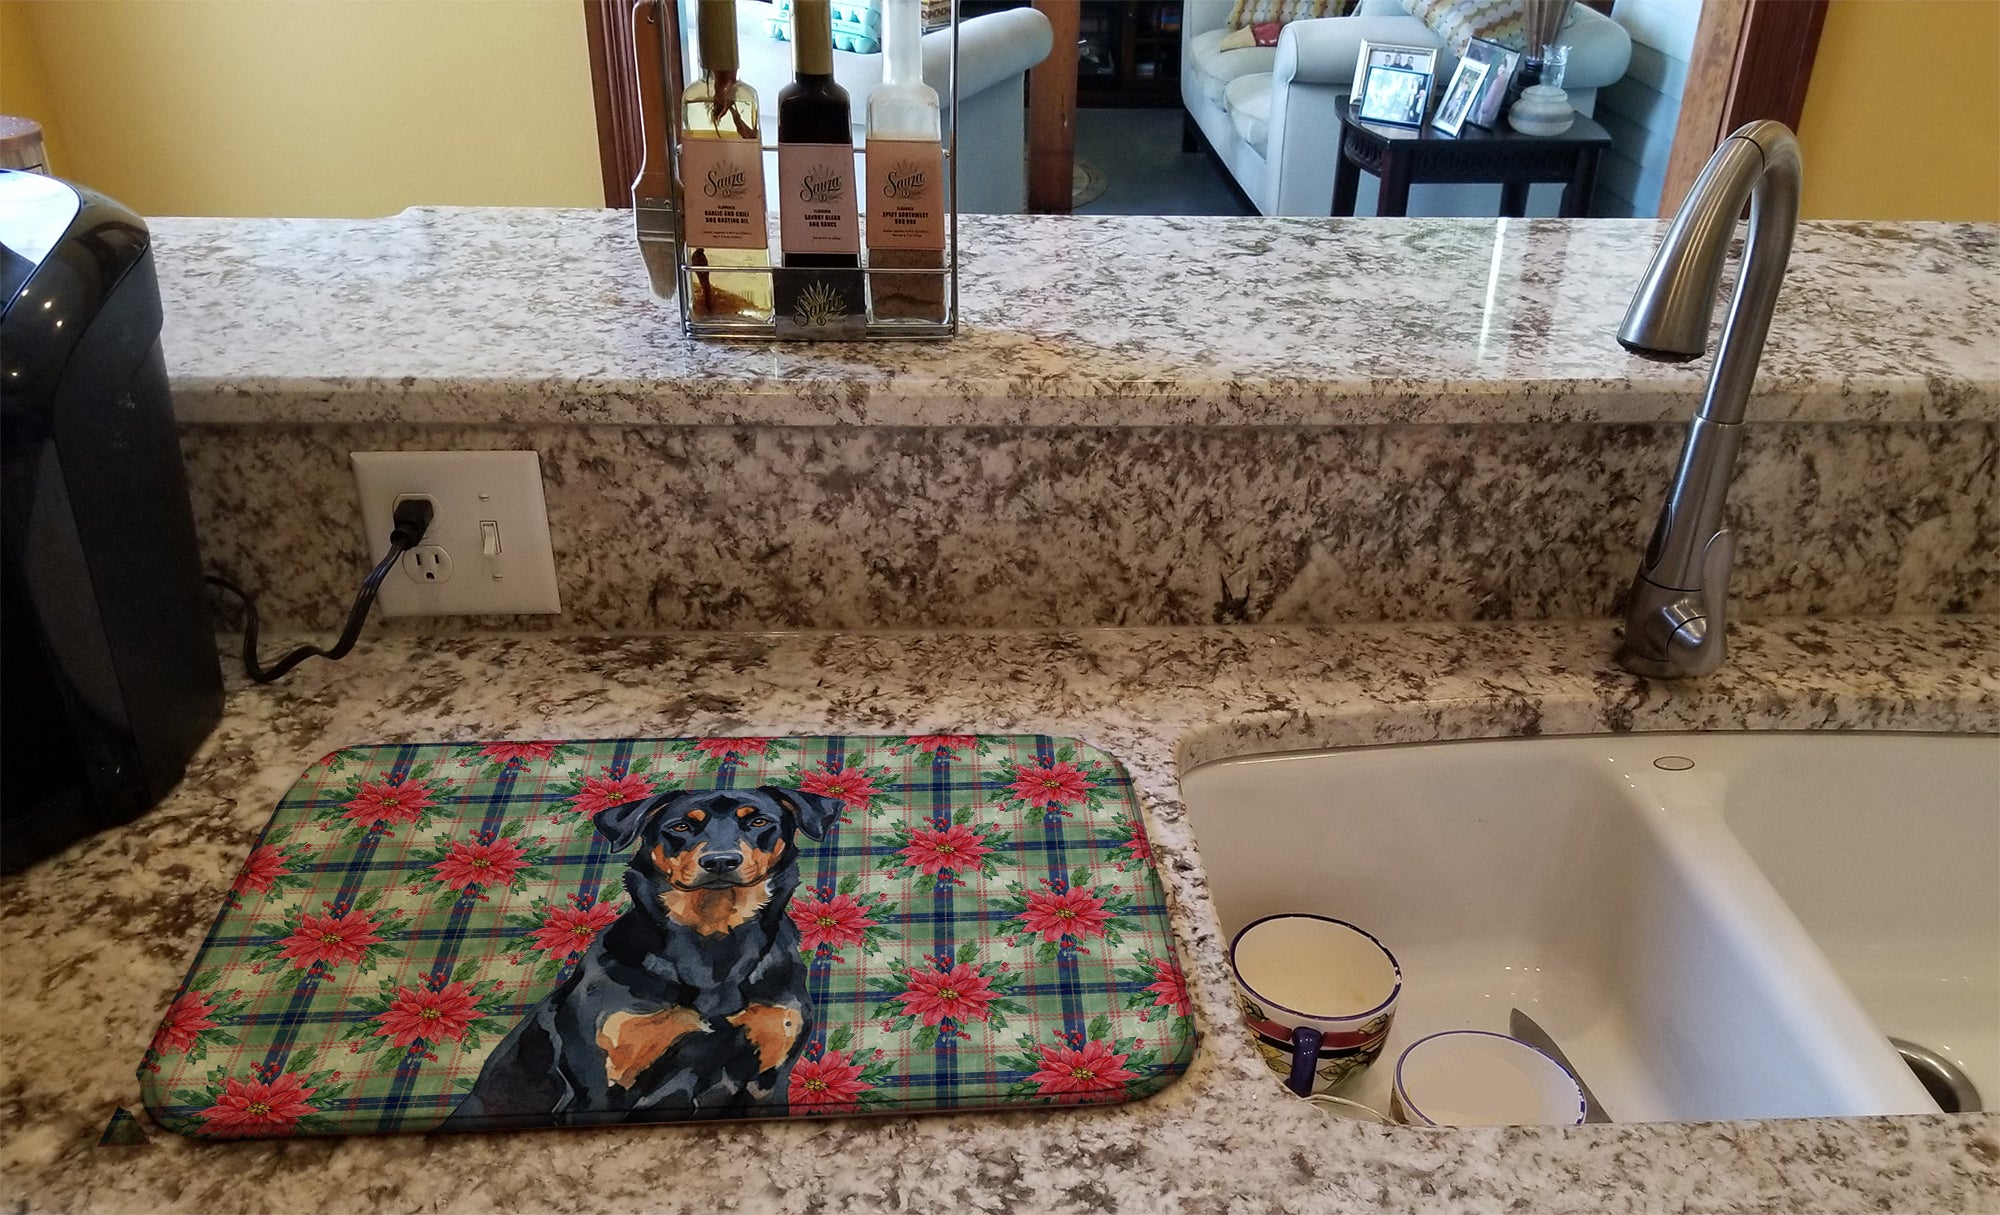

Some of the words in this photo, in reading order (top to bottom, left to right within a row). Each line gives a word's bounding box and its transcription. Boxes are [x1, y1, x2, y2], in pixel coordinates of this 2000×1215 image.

[703, 170, 746, 197] Sauza
[799, 175, 842, 202] Sauza
[883, 170, 924, 198] Sauza
